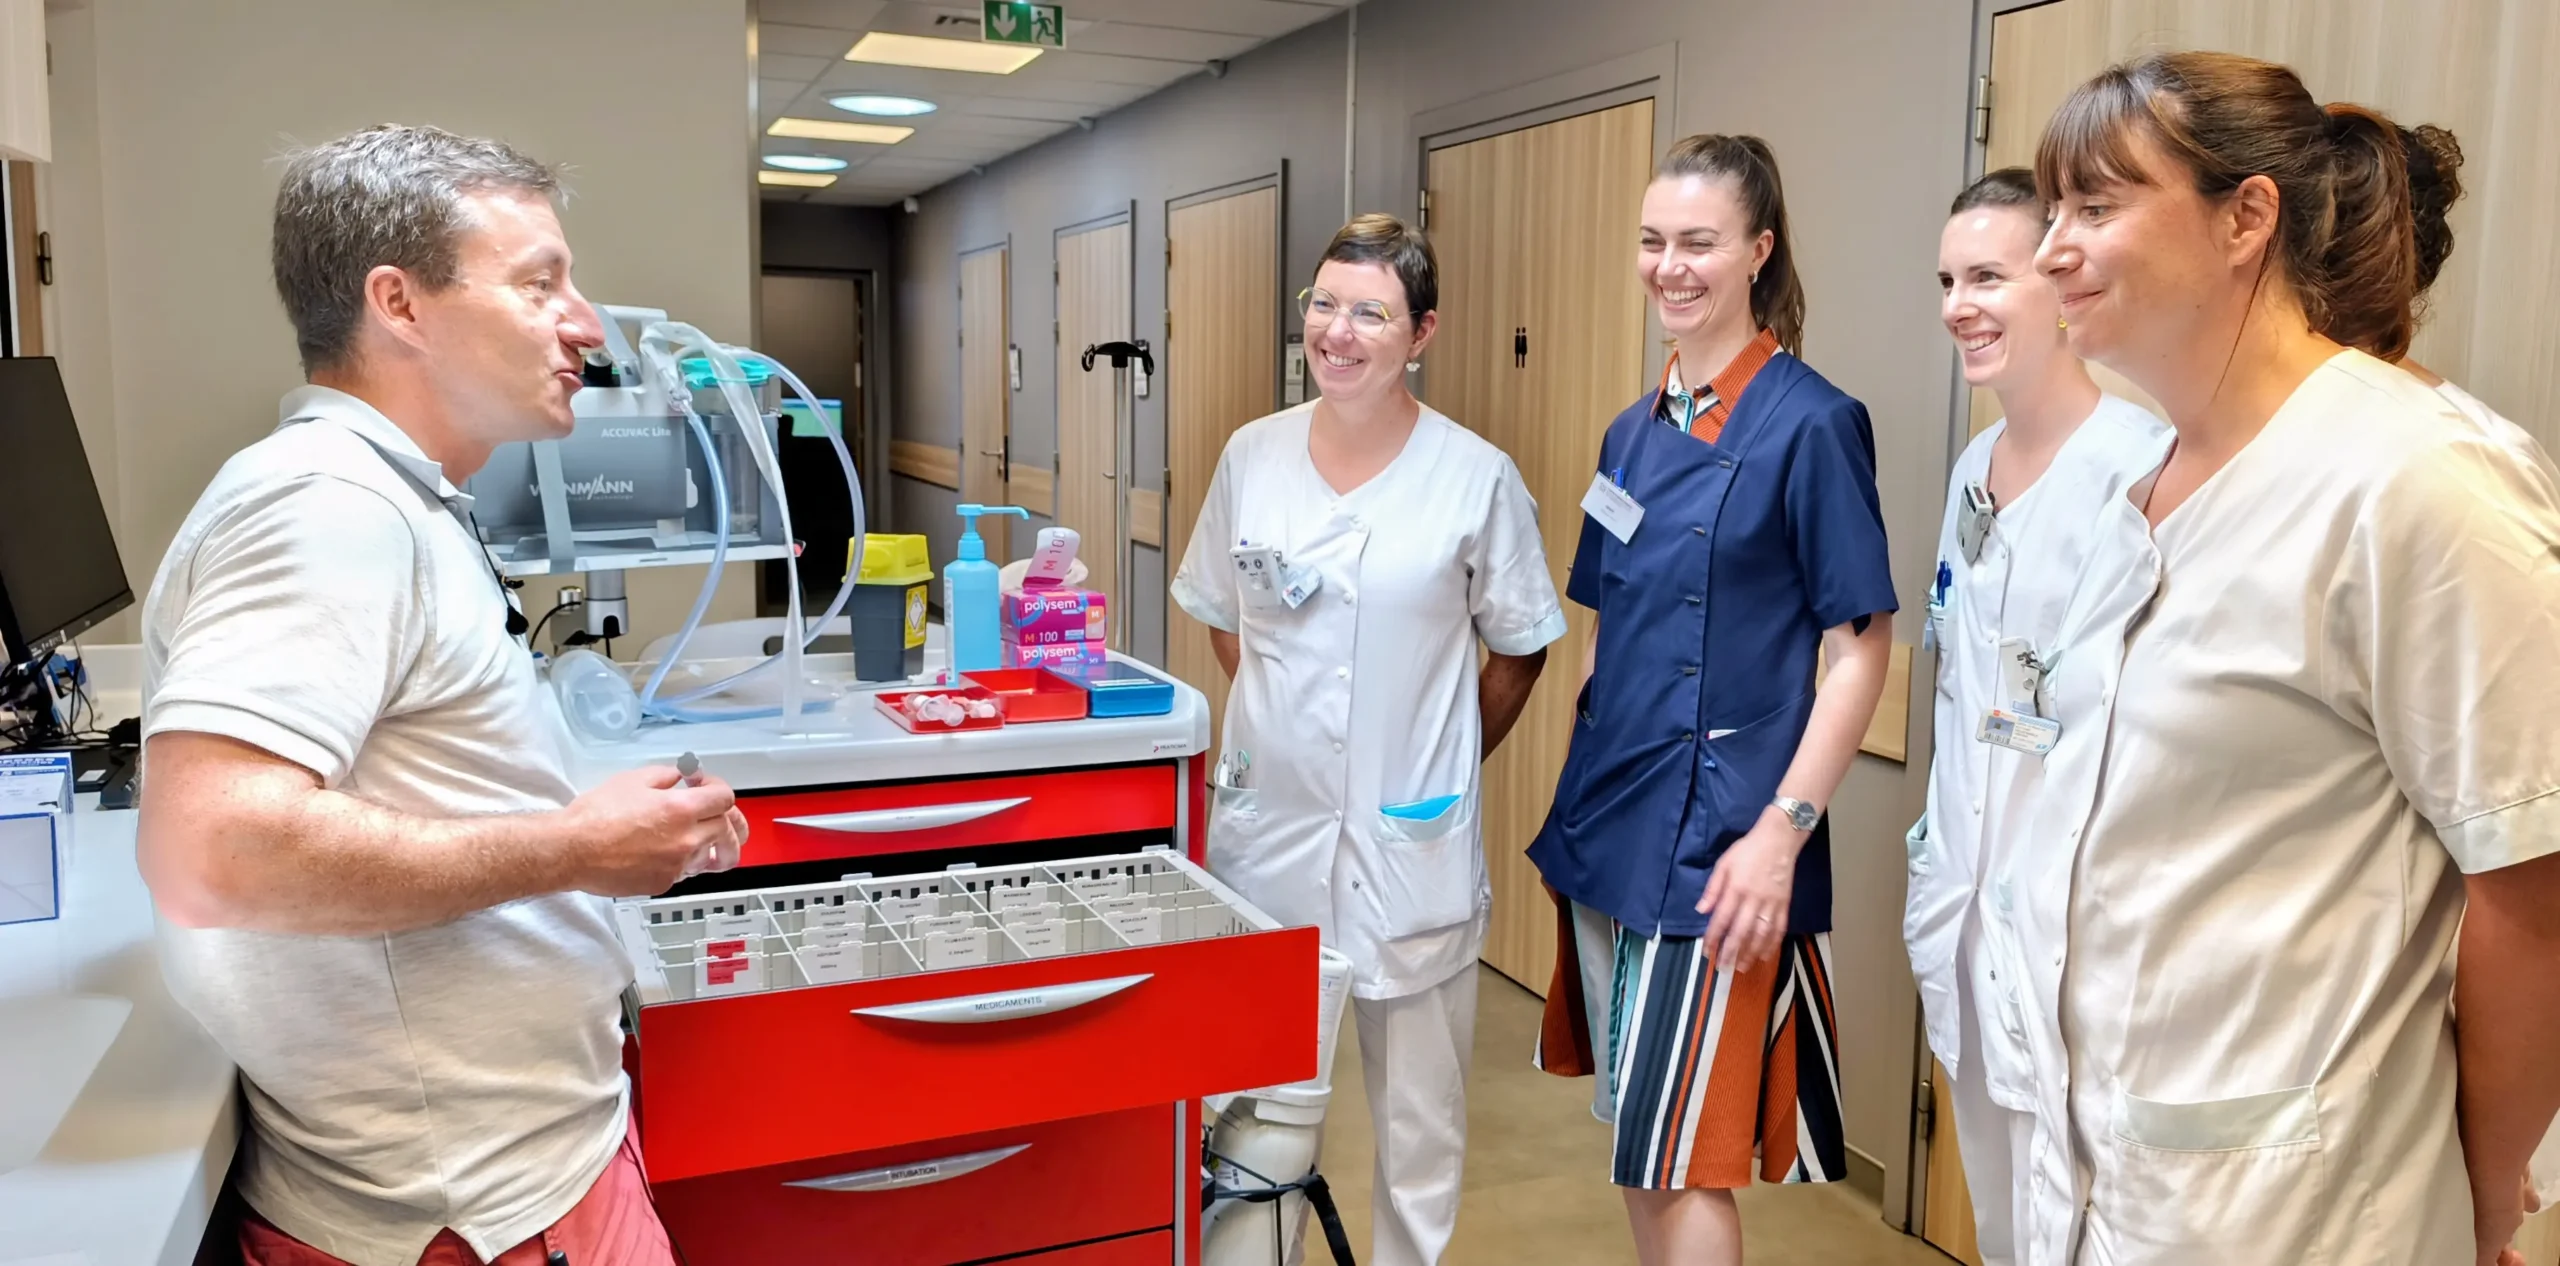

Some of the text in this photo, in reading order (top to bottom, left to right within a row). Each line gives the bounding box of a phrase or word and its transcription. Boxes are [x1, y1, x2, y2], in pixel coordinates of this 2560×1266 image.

[601, 426, 672, 438] ACCUVAC Lite
[1043, 560, 1058, 571] M
[1024, 599, 1077, 614] polysem
[1091, 610, 1100, 618] M
[1024, 633, 1035, 643] M
[1039, 631, 1059, 643] 100
[1022, 646, 1076, 661] polysem
[975, 995, 1042, 1011] MEDICAMENTS
